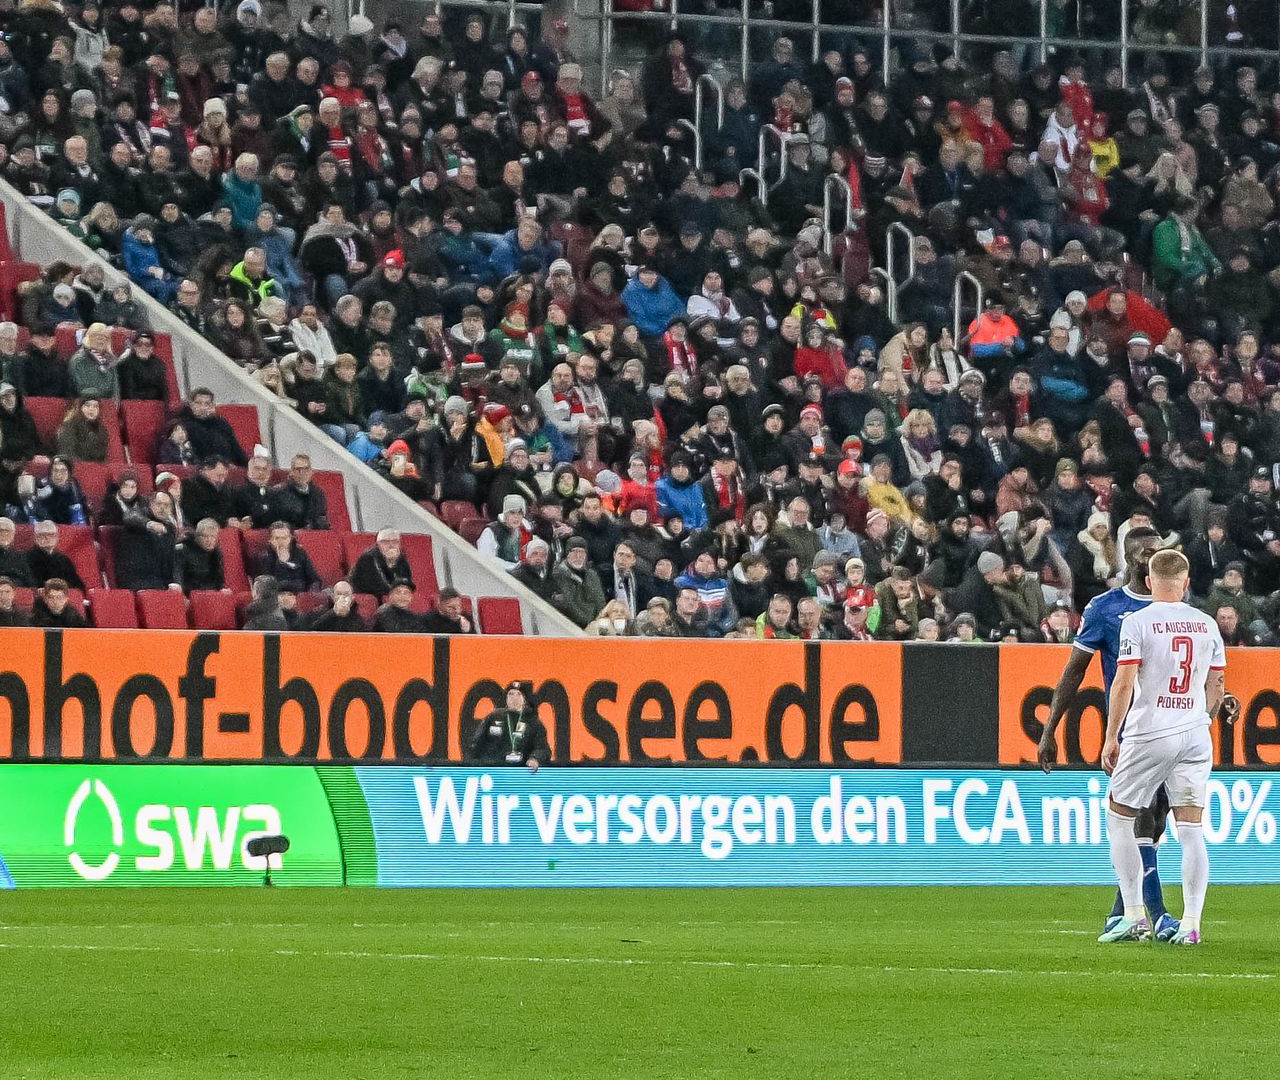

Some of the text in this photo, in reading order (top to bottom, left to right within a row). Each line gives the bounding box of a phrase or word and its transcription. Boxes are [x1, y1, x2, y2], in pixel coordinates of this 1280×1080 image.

[1152, 621, 1208, 634] FC AUGSBURG
[1169, 635, 1193, 694] 3
[136, 804, 282, 870] swa
[413, 773, 519, 845] Wir
[529, 793, 797, 859] versorgen
[811, 774, 915, 845] den
[925, 780, 1032, 845] FCA
